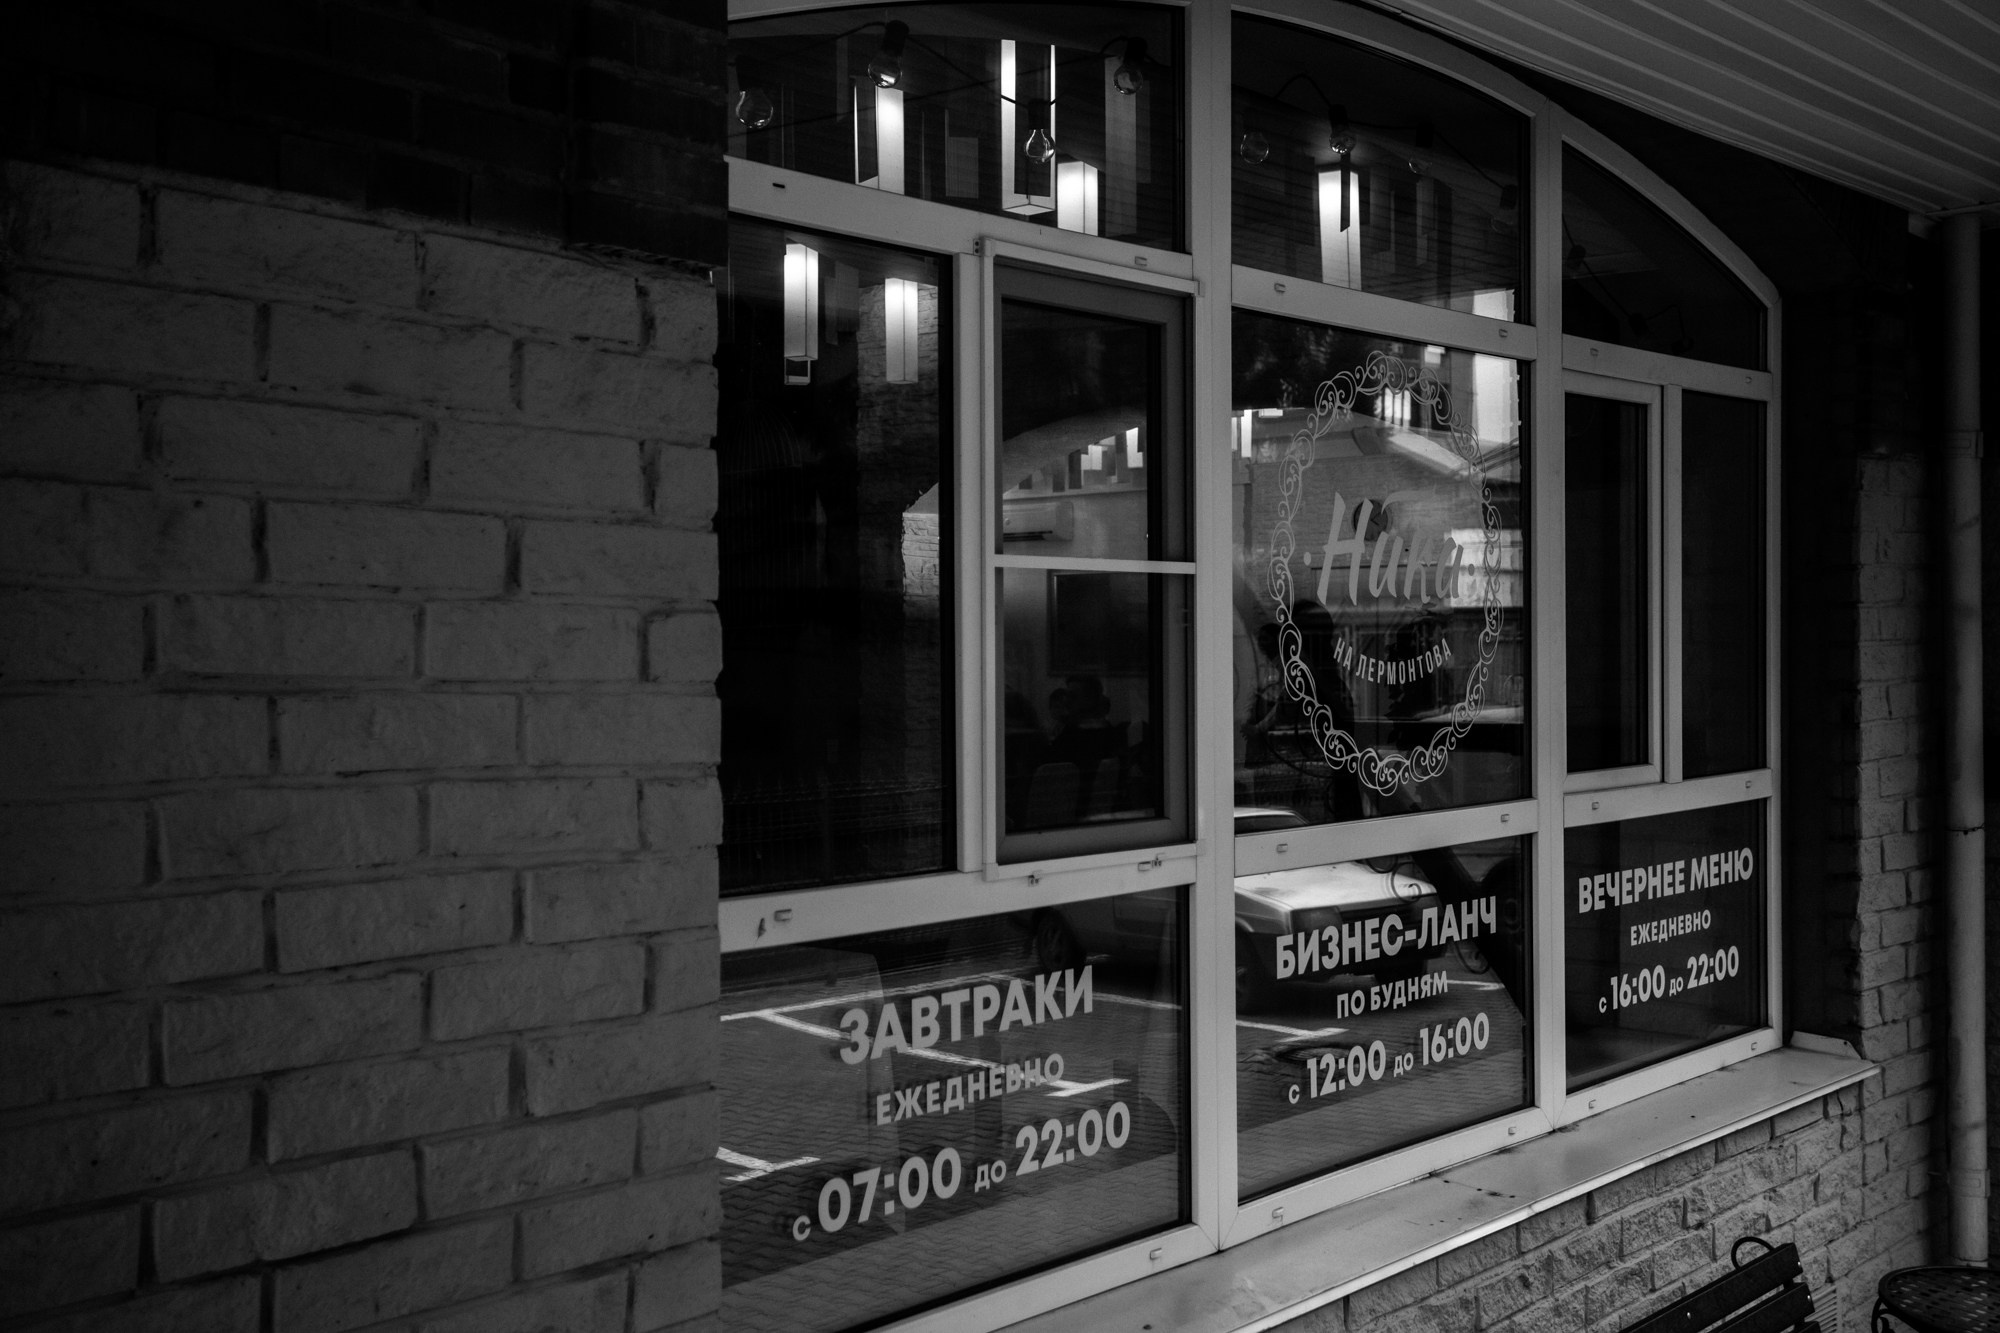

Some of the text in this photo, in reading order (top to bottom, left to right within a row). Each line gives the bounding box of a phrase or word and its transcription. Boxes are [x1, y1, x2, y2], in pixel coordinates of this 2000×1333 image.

[1333, 637, 1453, 685] НА ЛЕРМОНТОВА
[1578, 847, 1754, 914] ВЕЧЕРНЕЕ МЕНЮ
[1276, 896, 1497, 980] БИЗНЕС-ЛАНЧ
[1630, 909, 1712, 947] ЕЖЕДНЕВНО
[1336, 970, 1448, 1019] ПО БУДНЯМ
[1610, 965, 1666, 1011] 16:00
[1687, 945, 1740, 989] 22:00
[839, 964, 1094, 1065] ЗАВТРАКИ
[876, 1053, 1065, 1126] ЕЖЕДНЕВНО
[1306, 1039, 1386, 1100] 12:00
[1420, 1012, 1490, 1066] 16:00
[817, 1146, 962, 1233] 07:00
[1015, 1101, 1131, 1177] 22:00
